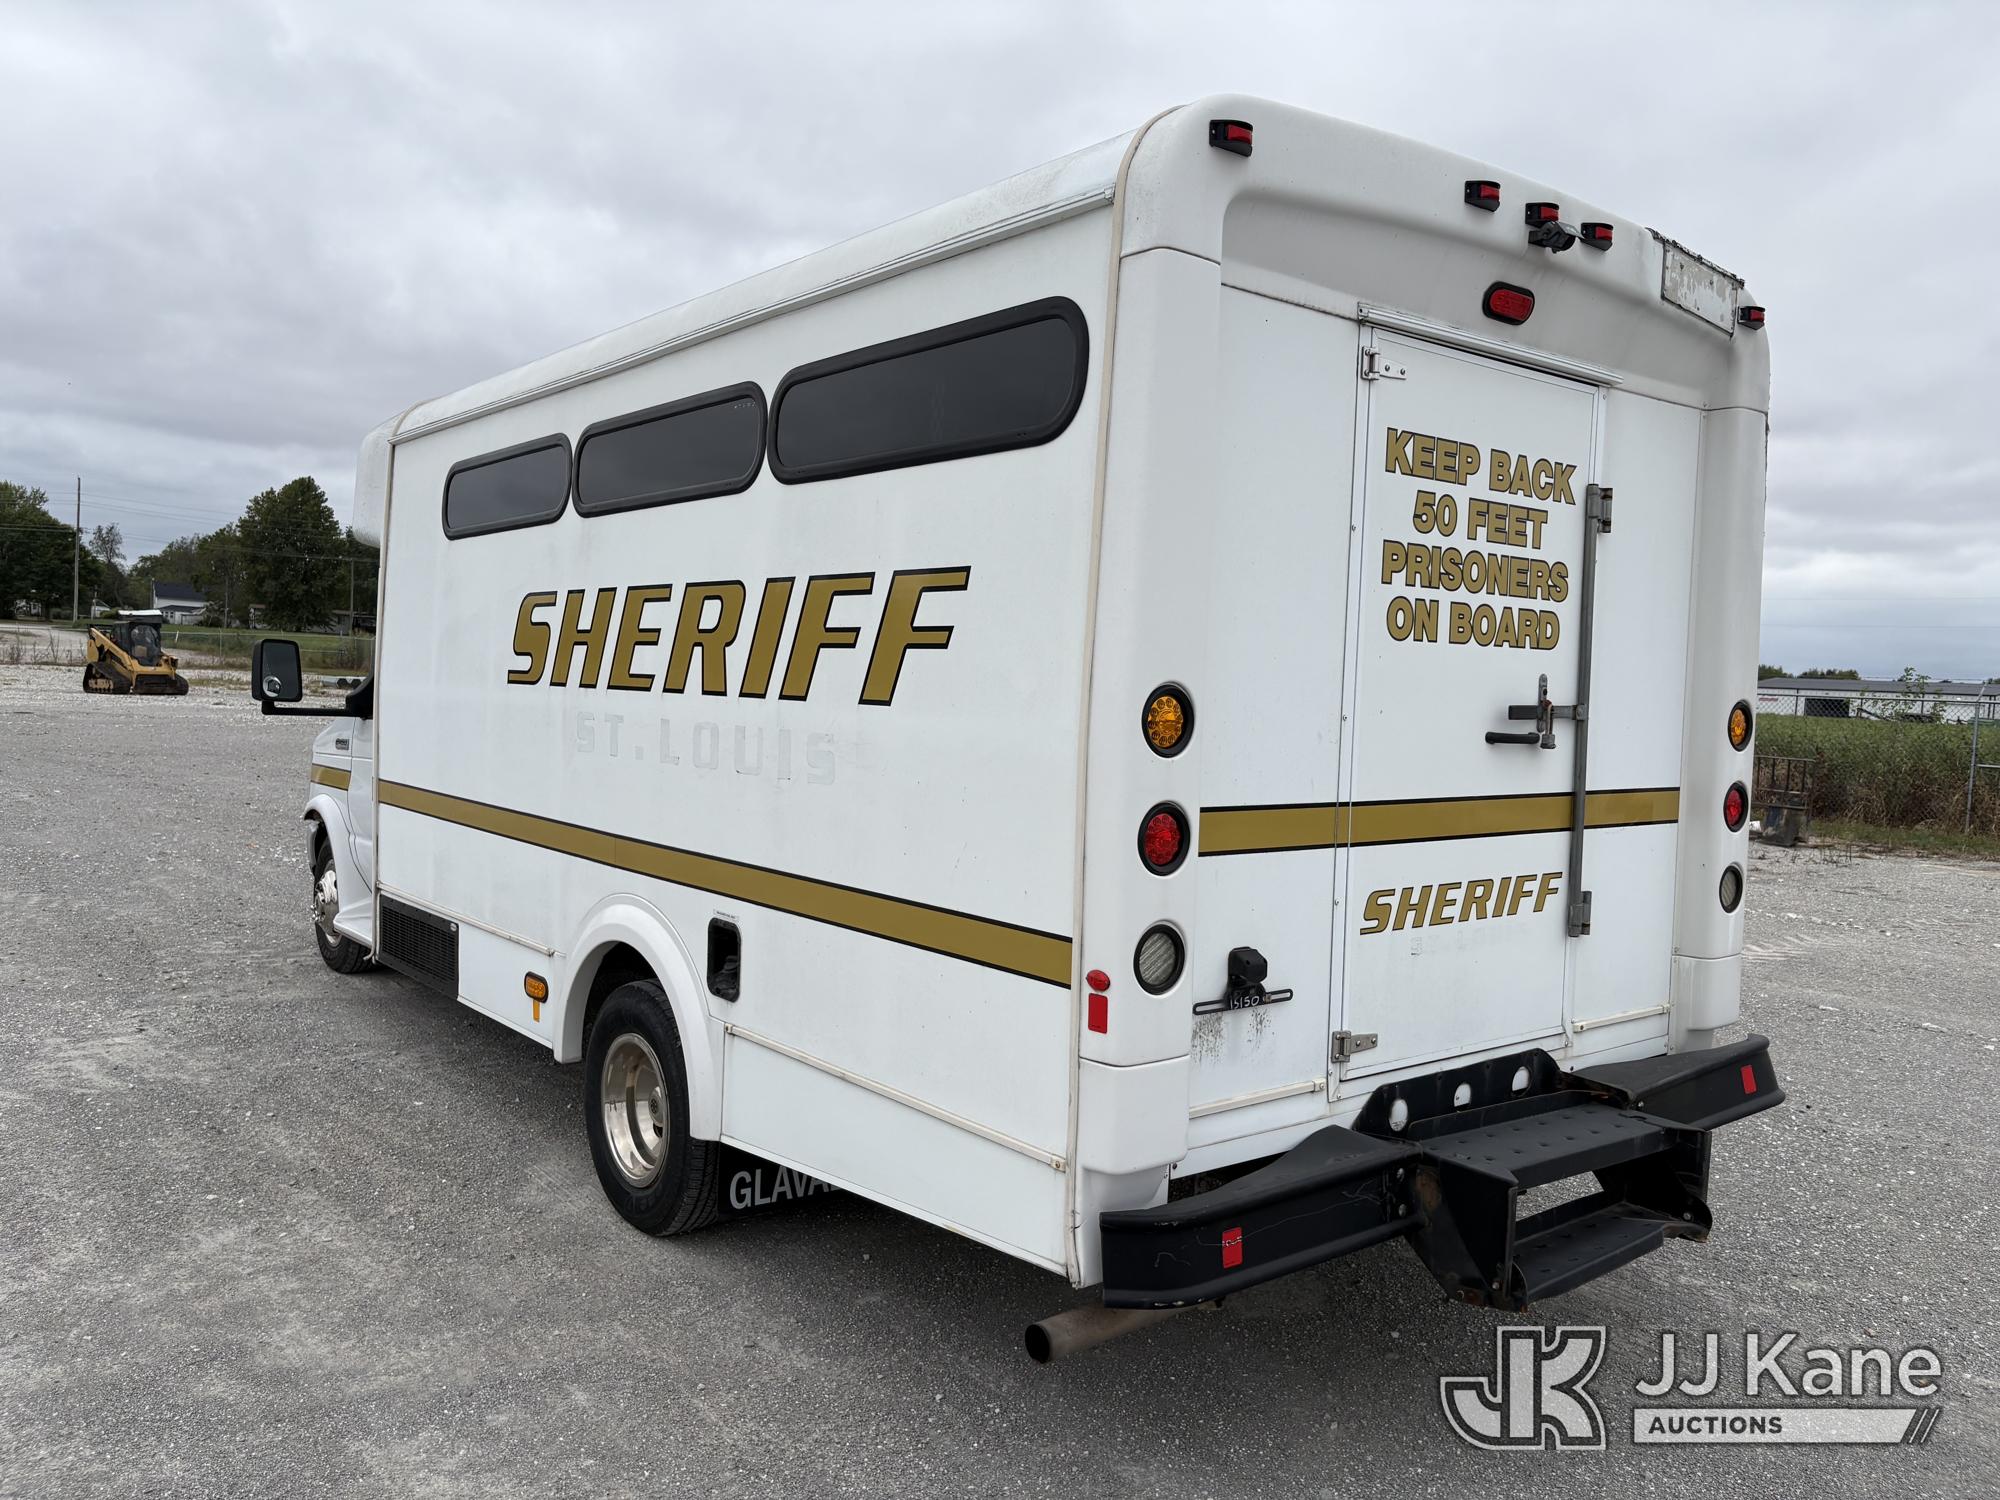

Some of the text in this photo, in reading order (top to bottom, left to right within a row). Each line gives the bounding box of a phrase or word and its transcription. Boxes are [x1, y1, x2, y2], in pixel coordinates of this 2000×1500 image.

[1385, 427, 1577, 505] KEEP BACK
[1412, 489, 1548, 549] 50 FEET
[1381, 539, 1569, 603] PRISONERS
[507, 565, 972, 706] SHERIFF
[1386, 595, 1560, 650] ON BOARD
[577, 711, 836, 785] ST. LOUIS
[1359, 871, 1563, 935] SHERIFF
